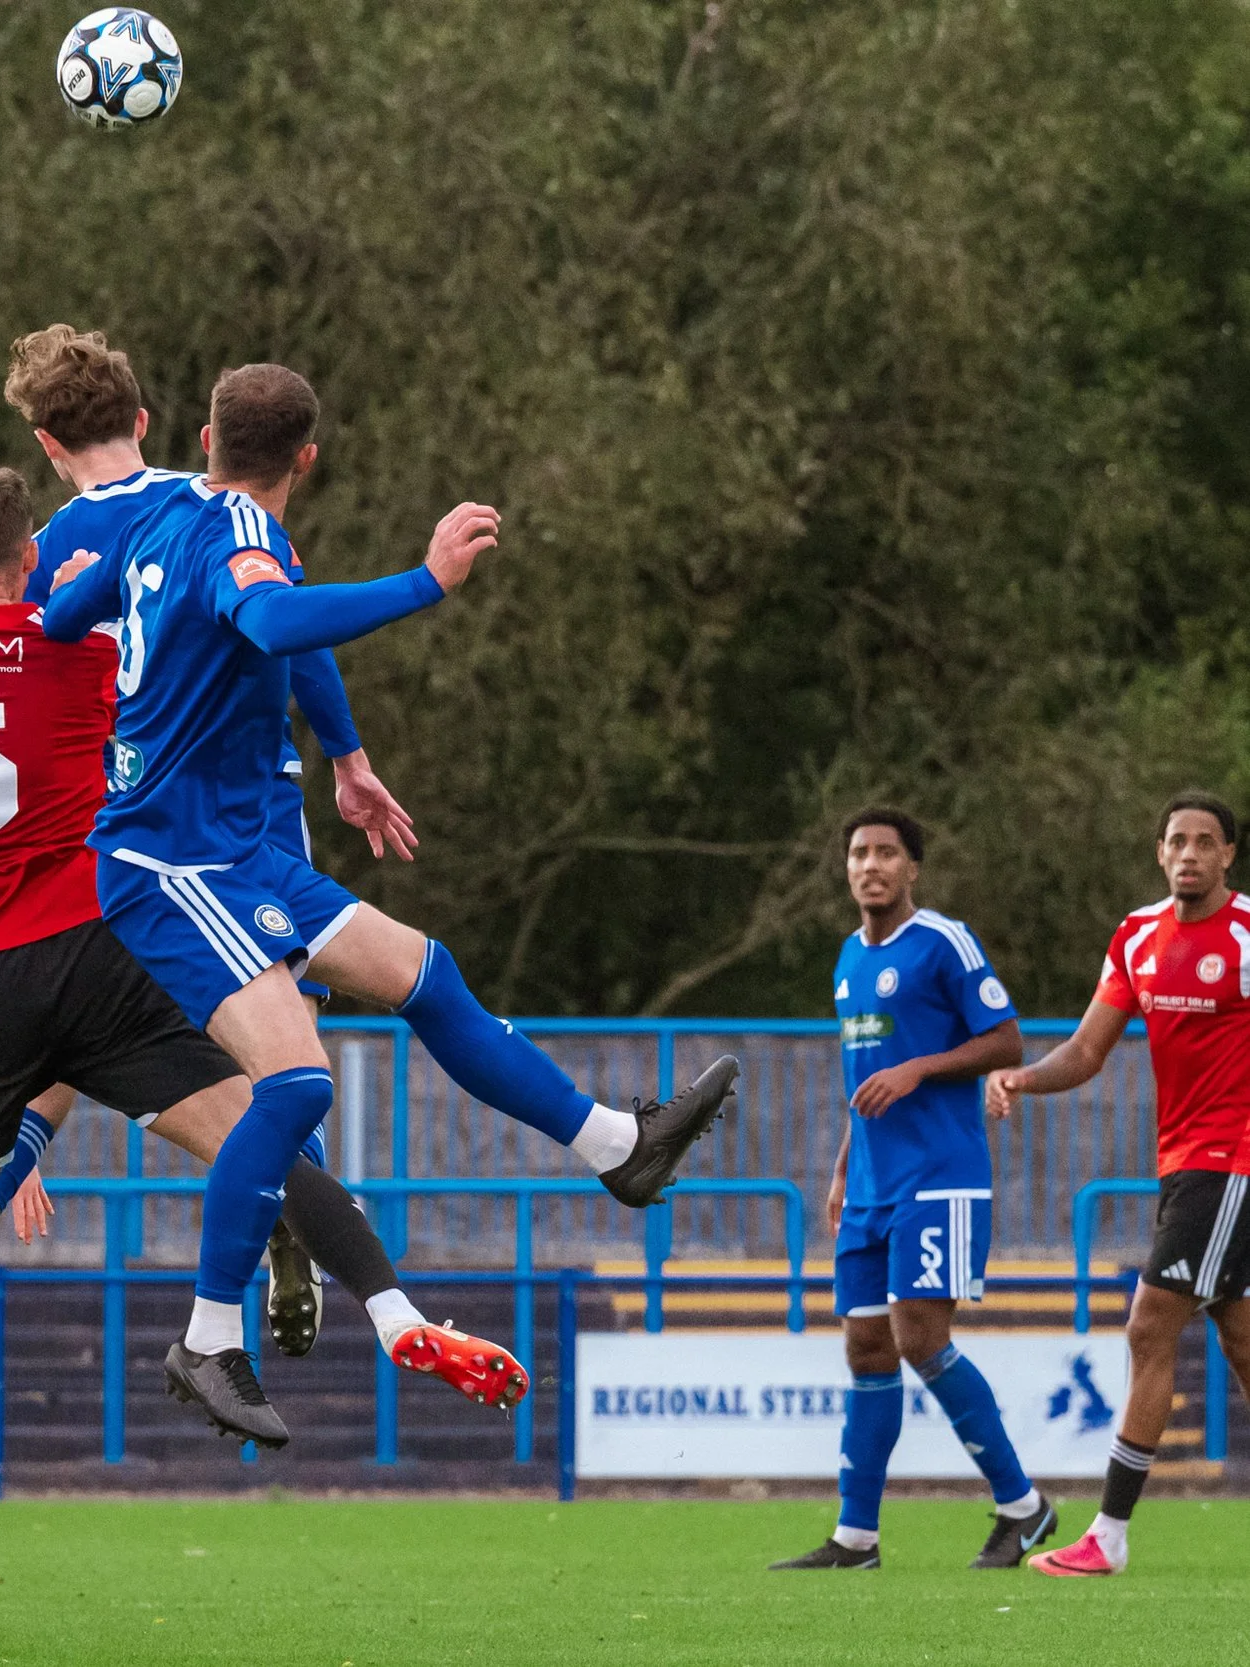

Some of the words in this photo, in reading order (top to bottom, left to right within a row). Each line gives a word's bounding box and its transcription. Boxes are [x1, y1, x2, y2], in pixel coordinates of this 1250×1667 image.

[67, 68, 86, 92] DELTA
[115, 741, 136, 777] EC
[920, 1226, 944, 1269] 5
[592, 1385, 747, 1416] REGIONAL
